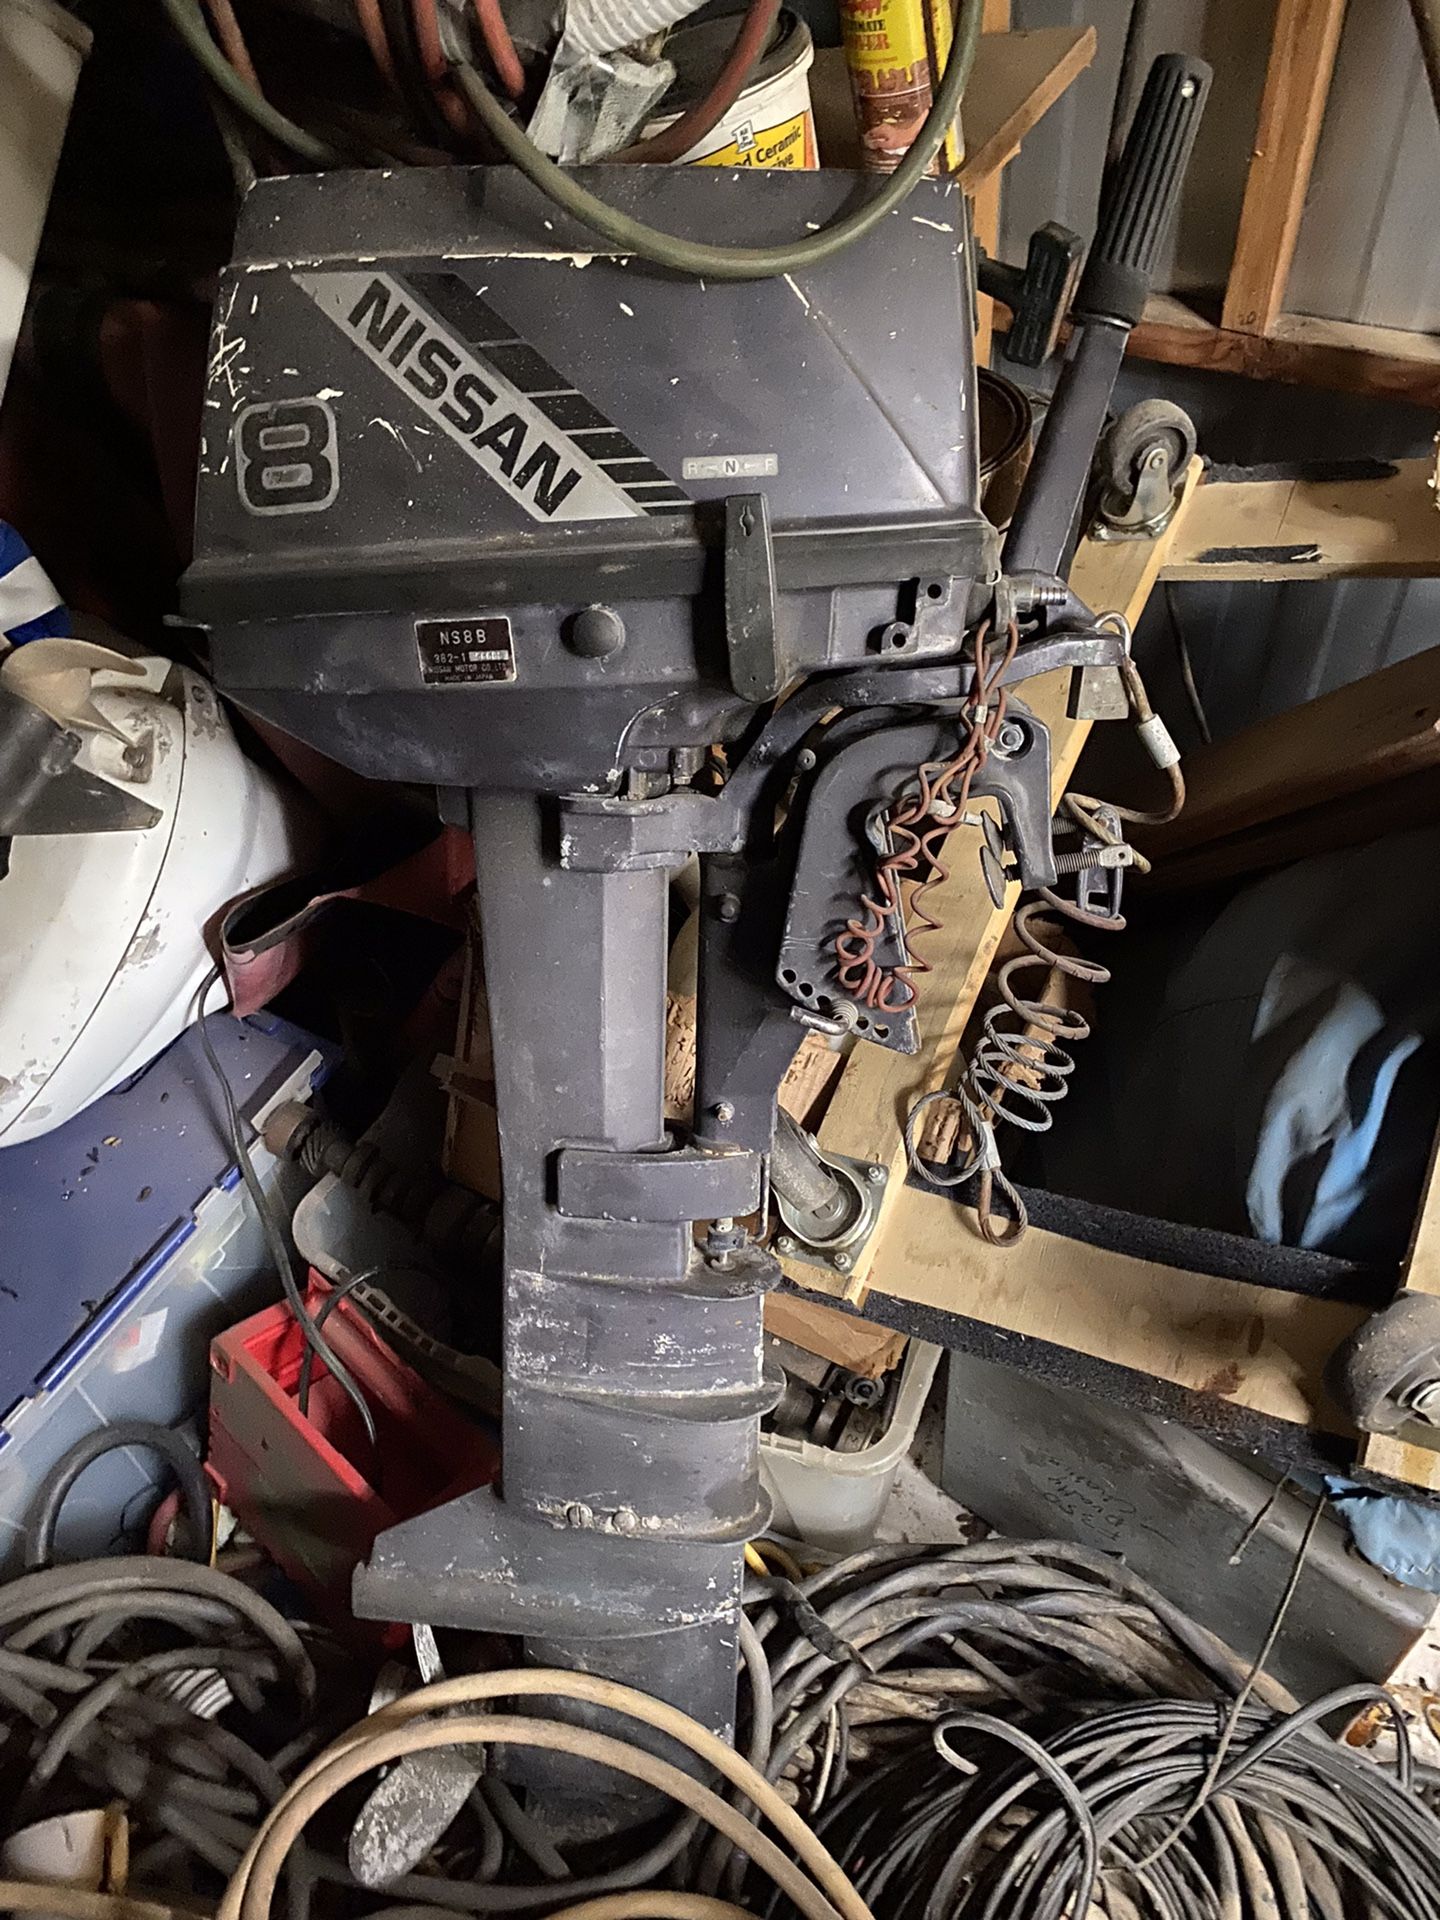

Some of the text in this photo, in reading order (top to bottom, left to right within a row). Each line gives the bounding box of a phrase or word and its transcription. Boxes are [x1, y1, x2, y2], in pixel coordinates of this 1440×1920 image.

[755, 125, 802, 163] Ceramic
[347, 278, 582, 517] NISSAN
[235, 396, 340, 517] 8
[725, 460, 736, 473] N
[764, 458, 774, 472] F
[440, 628, 486, 645] NS8B
